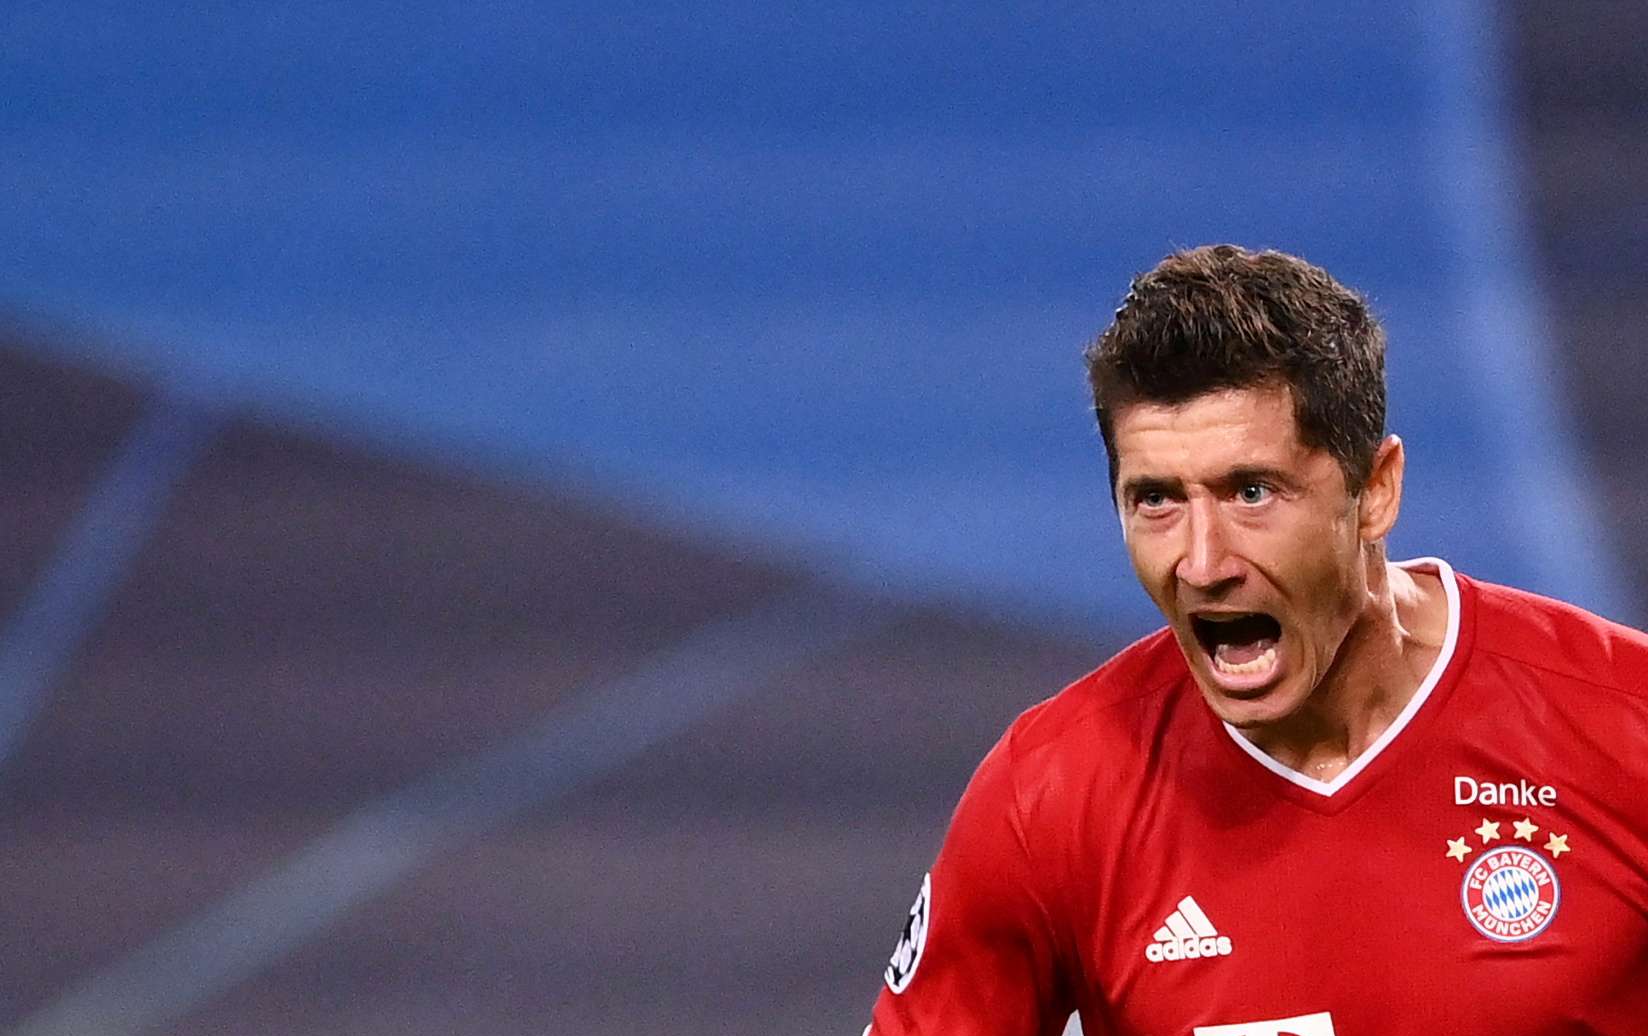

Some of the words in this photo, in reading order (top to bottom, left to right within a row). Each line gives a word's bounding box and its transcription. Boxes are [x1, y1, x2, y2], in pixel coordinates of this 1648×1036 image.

[1454, 776, 1557, 807] Danke
[1469, 863, 1489, 891] FC
[1487, 852, 1551, 886] BAYERN
[1145, 935, 1233, 963] adidas
